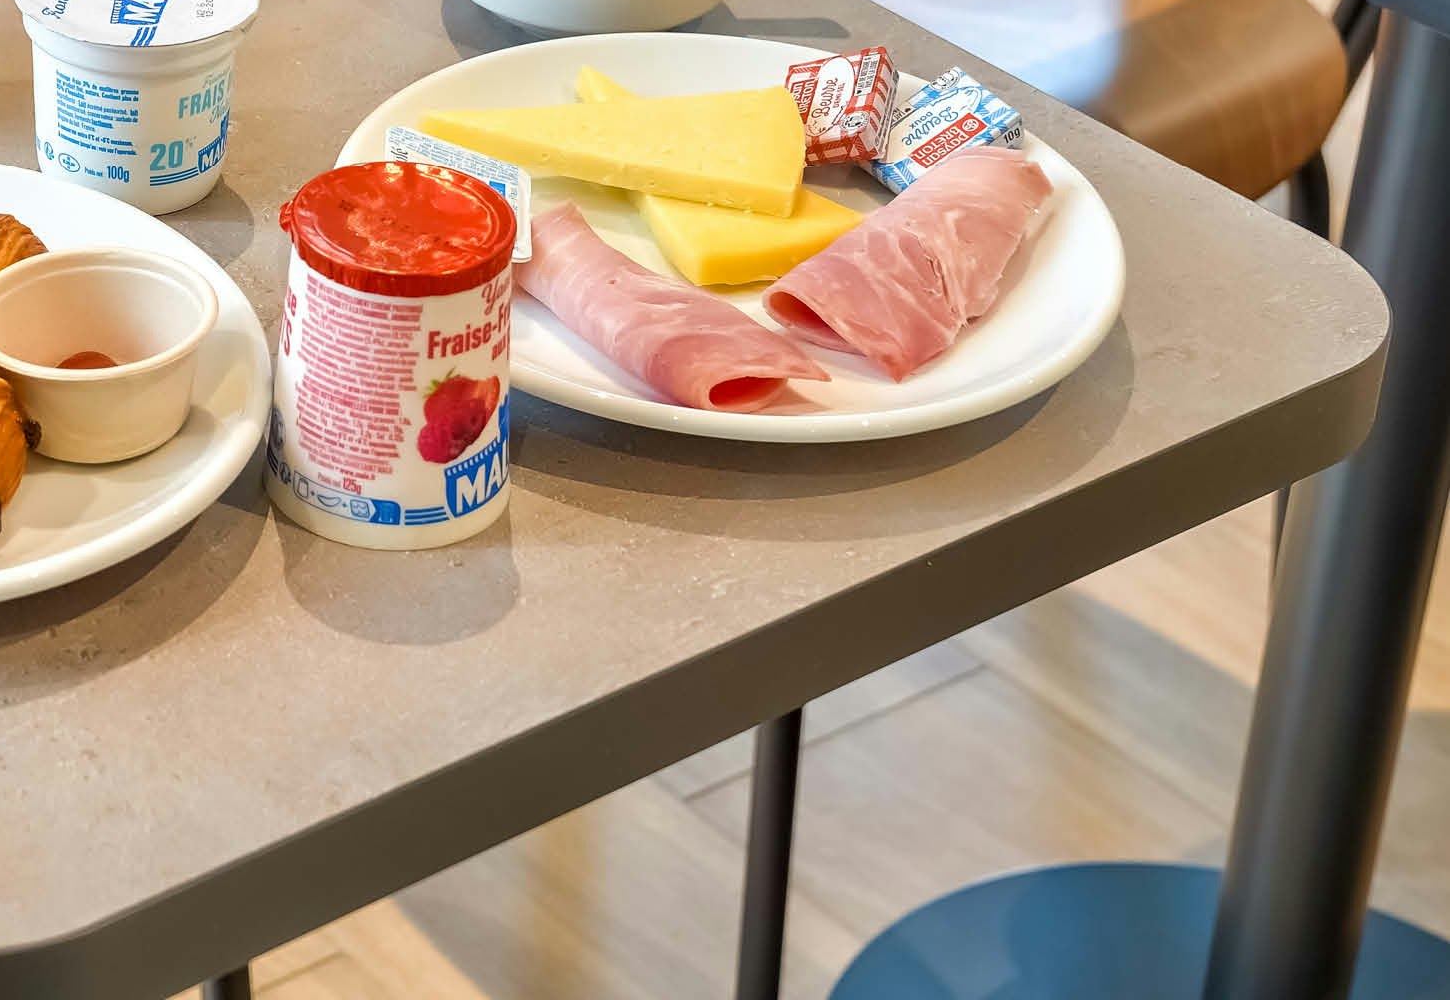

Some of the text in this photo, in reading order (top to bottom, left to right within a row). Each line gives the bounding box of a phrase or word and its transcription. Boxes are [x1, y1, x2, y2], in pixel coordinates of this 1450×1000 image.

[178, 79, 225, 120] FRAIS
[811, 77, 838, 118] Beurre
[902, 106, 959, 146] Beurre
[909, 111, 933, 130] DOUX
[1003, 127, 1021, 144] 10g
[149, 140, 183, 171] 20
[107, 165, 130, 183] 100g
[343, 477, 362, 495] 125g
[455, 439, 509, 514] MAL
